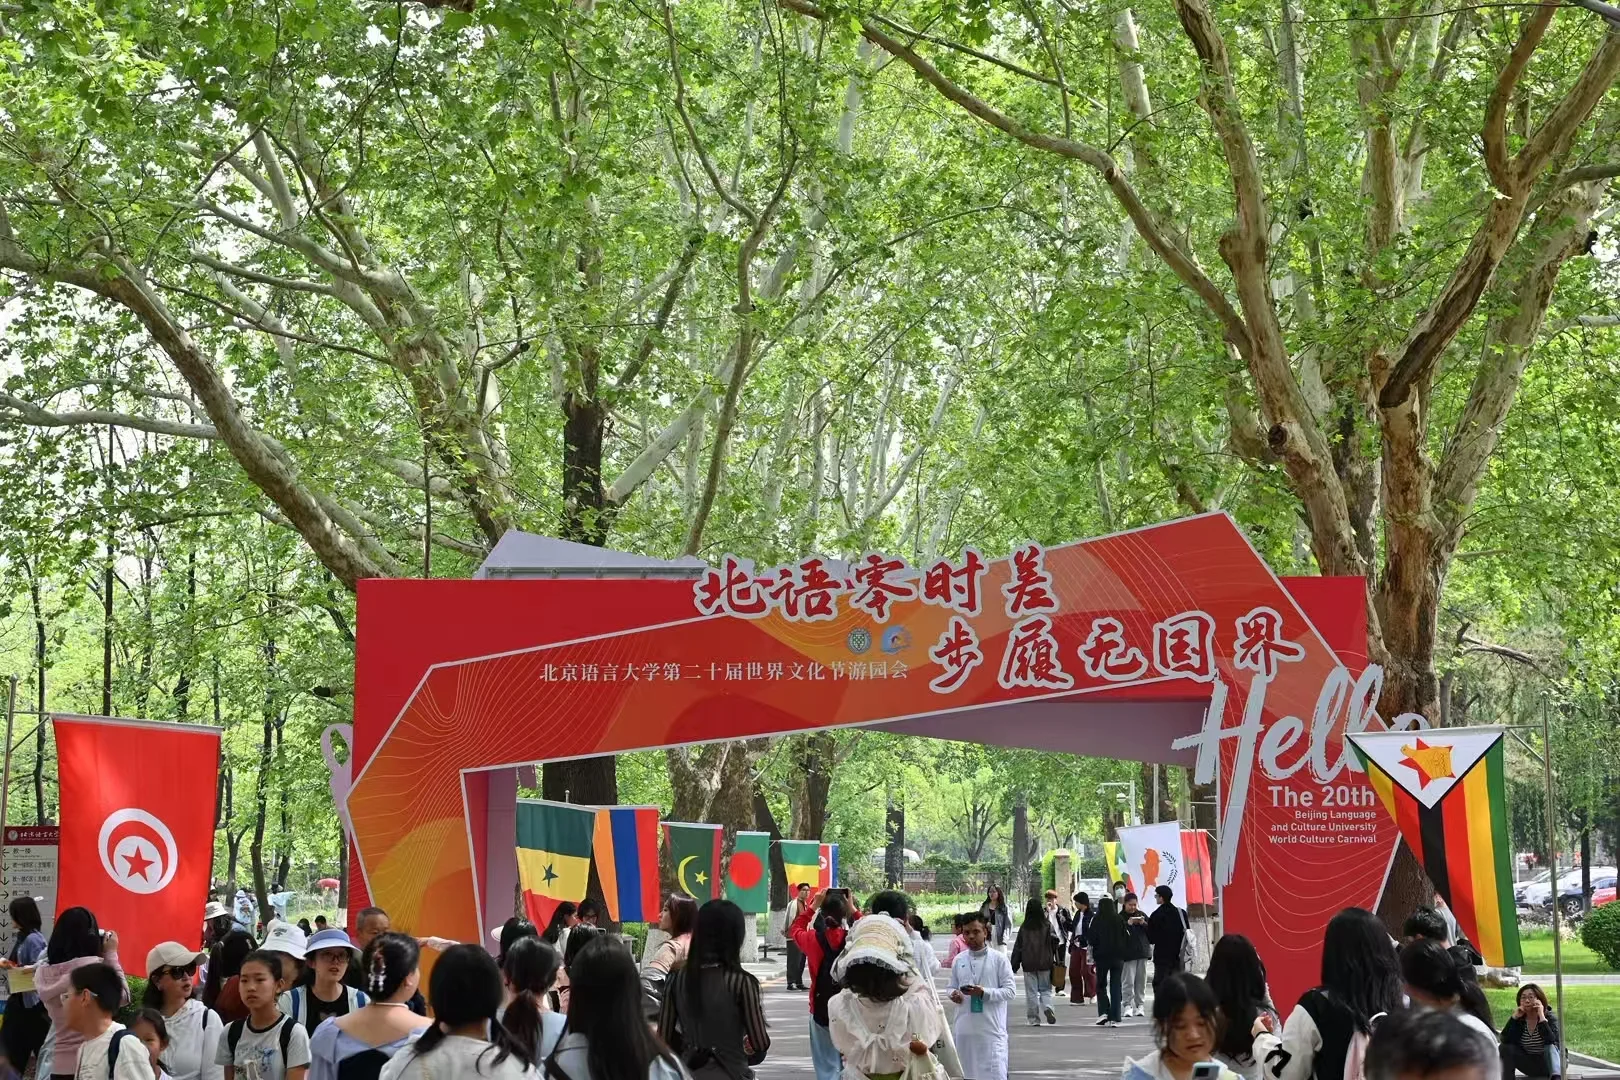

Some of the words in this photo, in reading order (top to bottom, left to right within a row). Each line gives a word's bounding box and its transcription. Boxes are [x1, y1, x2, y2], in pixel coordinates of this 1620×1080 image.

[695, 543, 1058, 622] 北语零时差
[931, 609, 1301, 690] 步履无国界
[539, 659, 908, 682] 北京语言大学第二十届世界文化节游园会
[1171, 663, 1430, 886] Hell
[1268, 786, 1313, 807] The
[1321, 785, 1375, 807] 20th
[1295, 810, 1327, 820] Beijing
[1330, 810, 1376, 820] Language
[1271, 823, 1288, 831] and
[1291, 823, 1326, 831] Culture
[1328, 822, 1377, 832] University
[1269, 835, 1297, 843] World
[1299, 835, 1335, 843] Culture
[1337, 834, 1377, 843] Carnival
